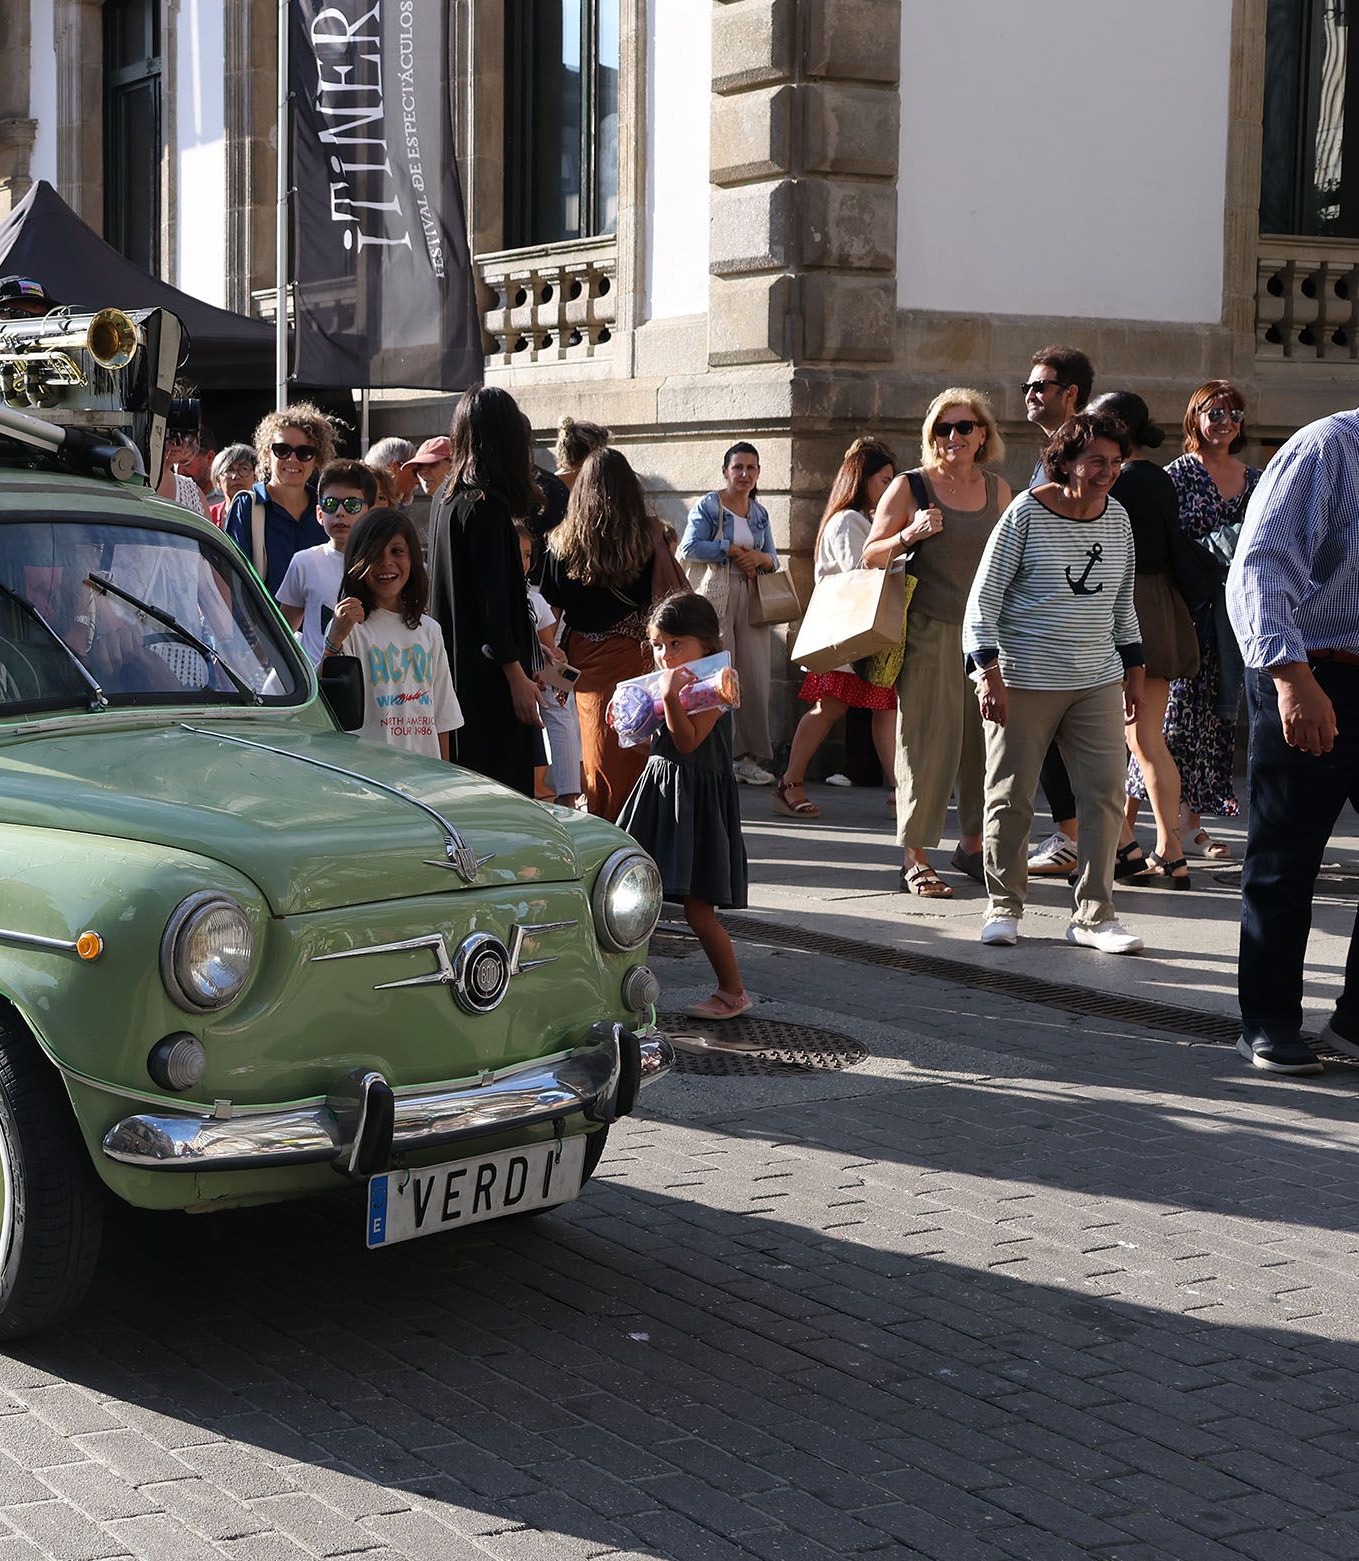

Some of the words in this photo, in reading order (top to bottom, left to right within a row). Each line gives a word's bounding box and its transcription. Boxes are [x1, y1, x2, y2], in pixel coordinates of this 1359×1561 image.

[397, 1, 421, 159] ESPECTÁCULOS
[409, 163, 425, 192] DE
[390, 727, 412, 736] TOUR
[414, 727, 433, 736] 1986
[412, 1150, 555, 1229] VERDI
[373, 1217, 382, 1233] E
